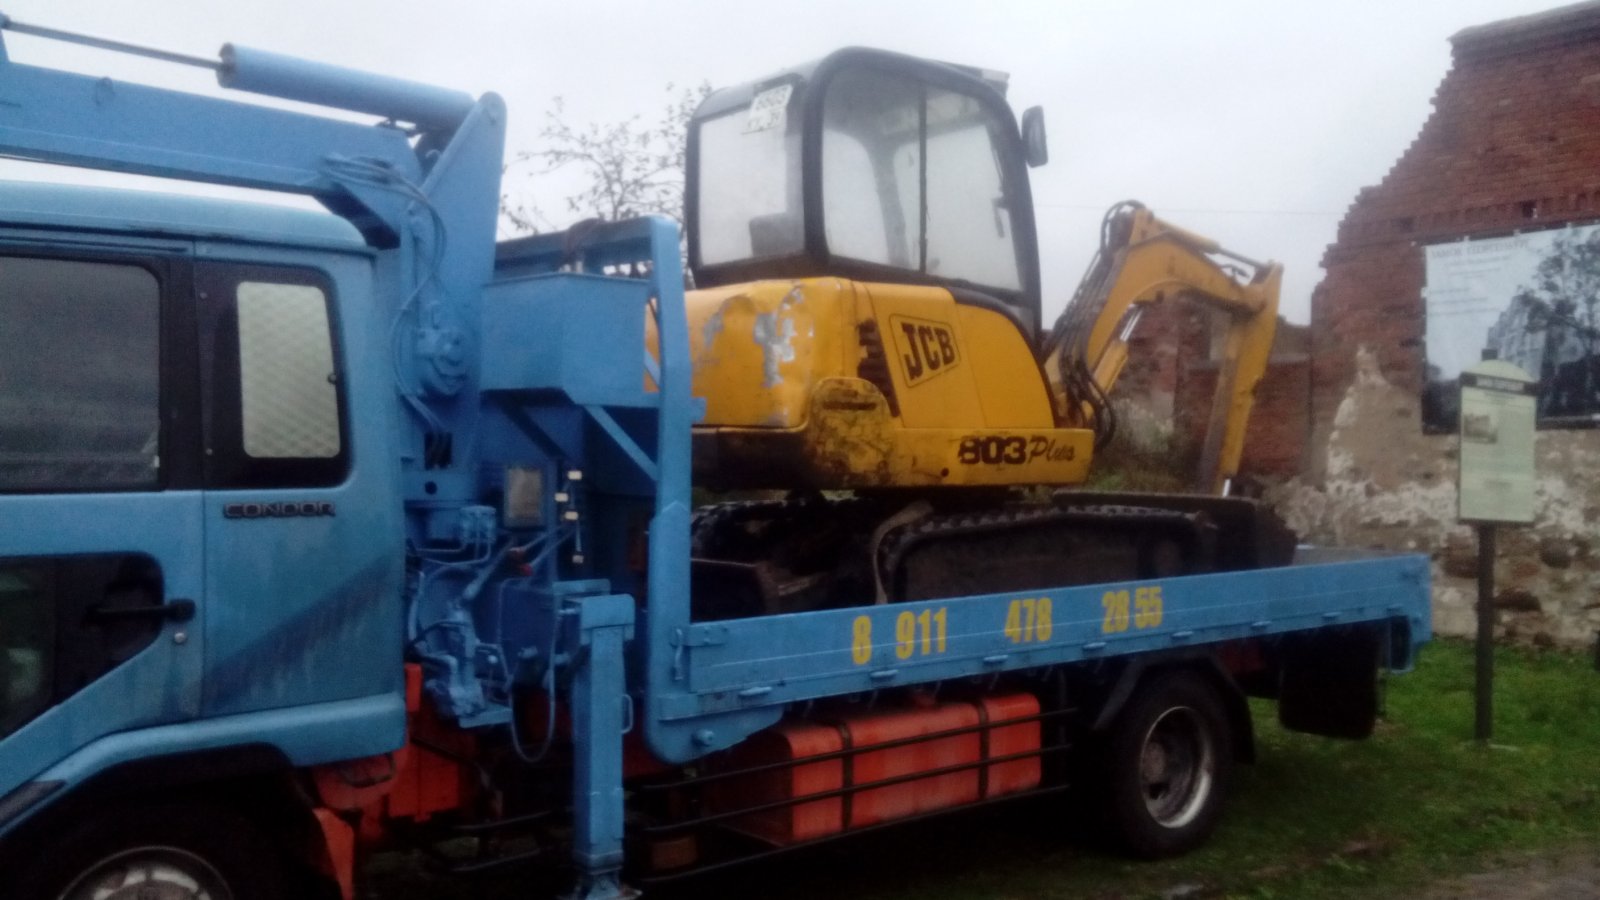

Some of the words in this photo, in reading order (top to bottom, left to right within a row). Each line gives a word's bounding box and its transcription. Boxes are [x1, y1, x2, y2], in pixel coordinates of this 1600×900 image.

[901, 322, 955, 381] JCB
[958, 435, 1026, 465] 803
[1027, 435, 1076, 463] Plus
[223, 501, 336, 518] CONDOR
[851, 615, 872, 665] 8
[896, 607, 948, 660] 911
[1004, 597, 1053, 644] 478
[1102, 590, 1130, 634] 28
[1135, 586, 1163, 629] 55
